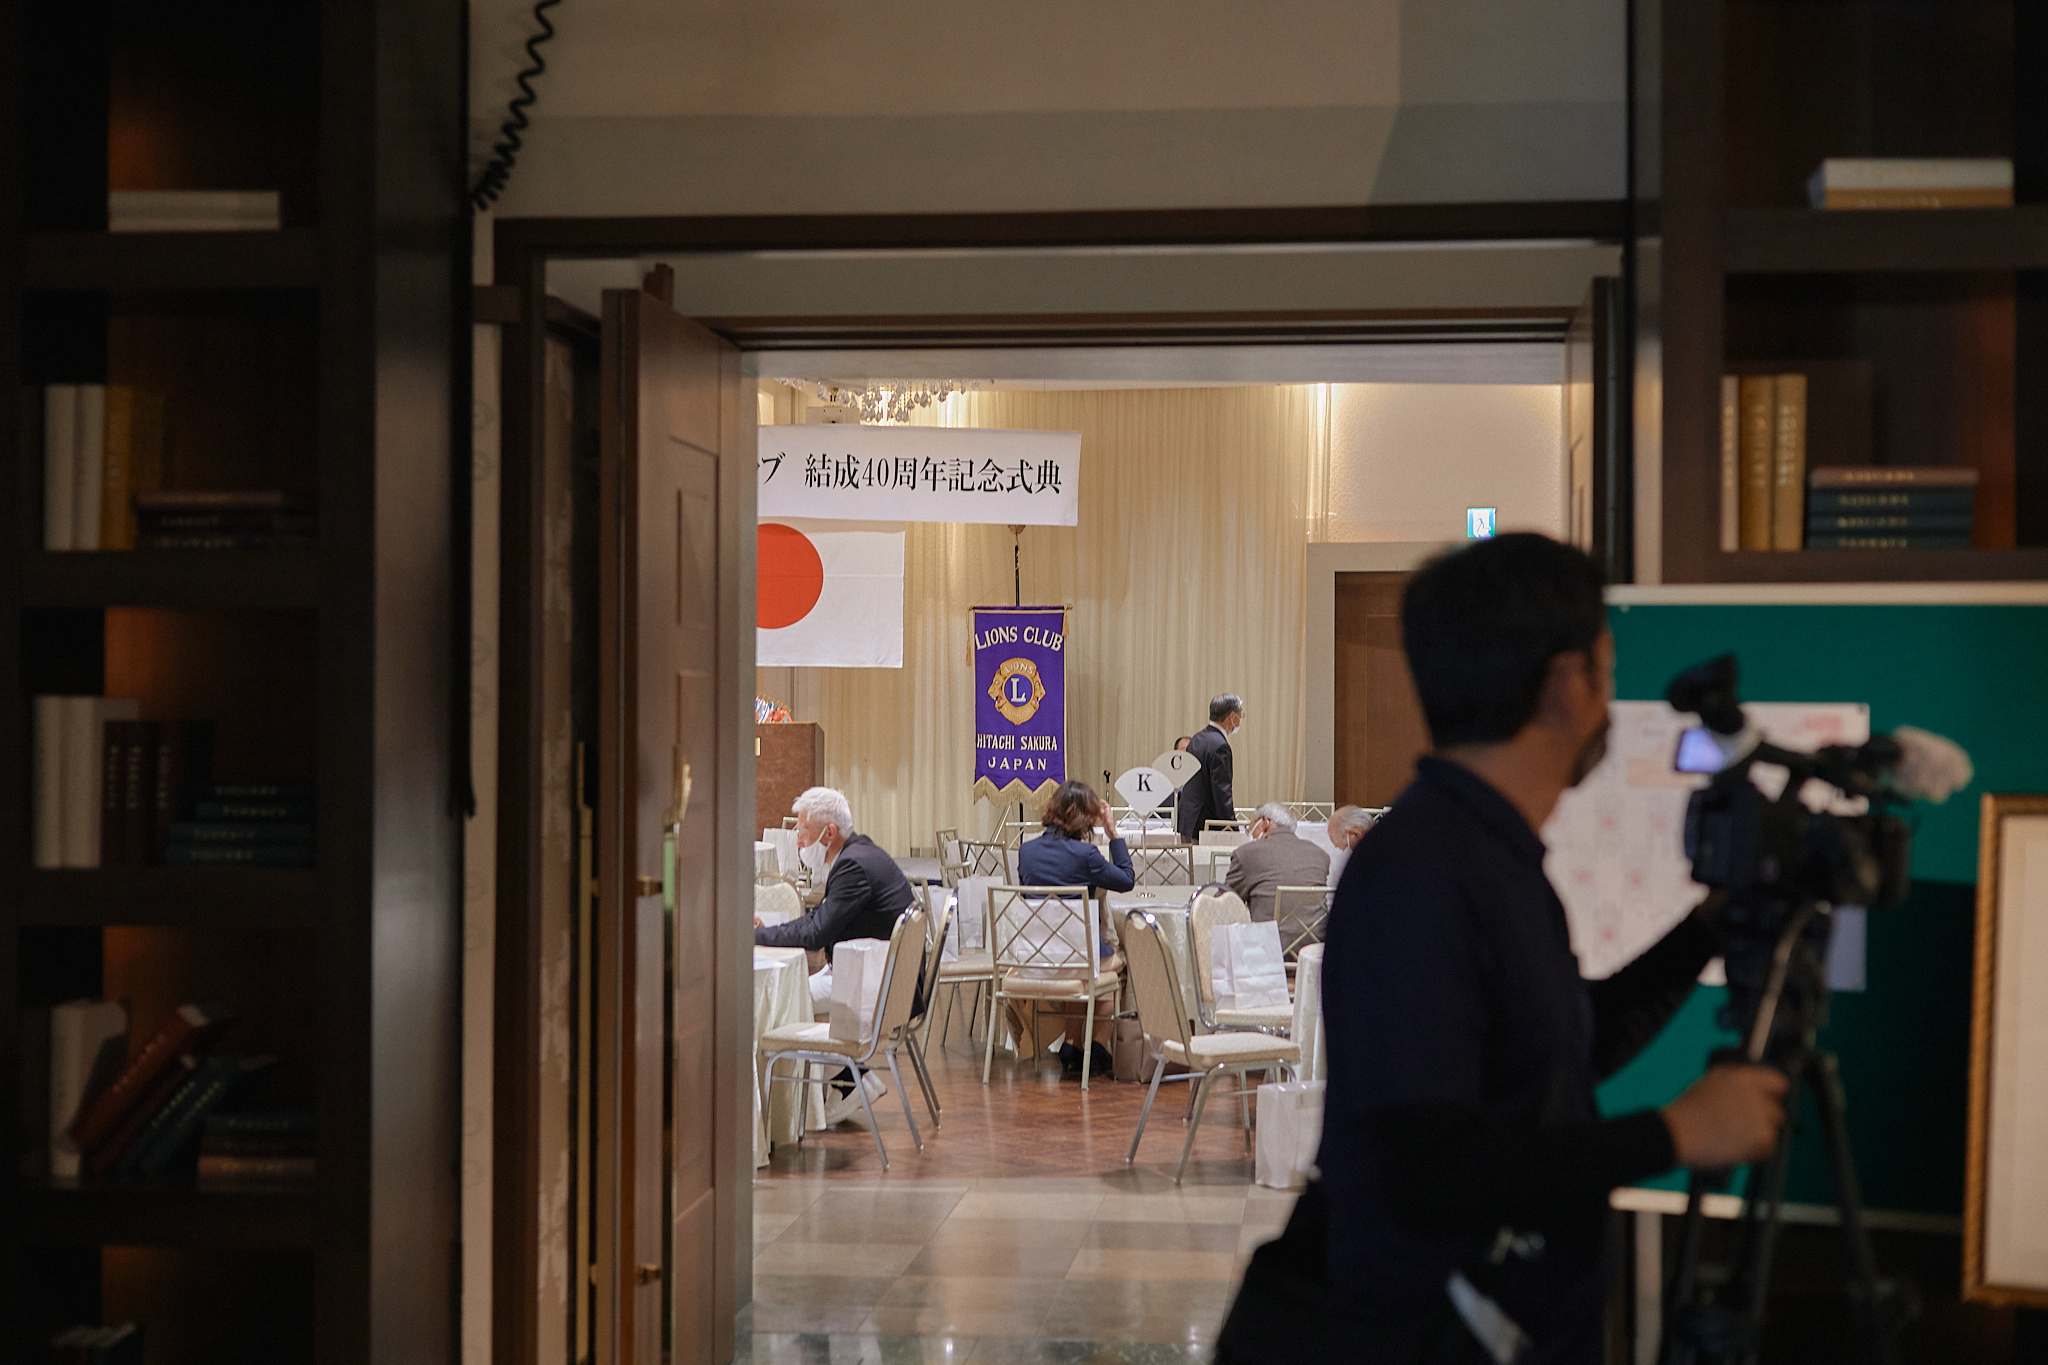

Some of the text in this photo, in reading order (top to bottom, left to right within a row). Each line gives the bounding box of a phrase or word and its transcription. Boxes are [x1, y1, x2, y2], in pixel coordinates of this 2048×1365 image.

[757, 451, 1062, 494] ブ 結成40周年記念式典
[975, 626, 1063, 652] LIONS CLUB
[1004, 662, 1034, 675] LIONS
[1010, 677, 1027, 703] L
[977, 733, 1058, 751] HITACHI SAKURA
[988, 756, 1047, 771] JAPAN
[1170, 754, 1182, 770] C
[1137, 773, 1153, 792] K
